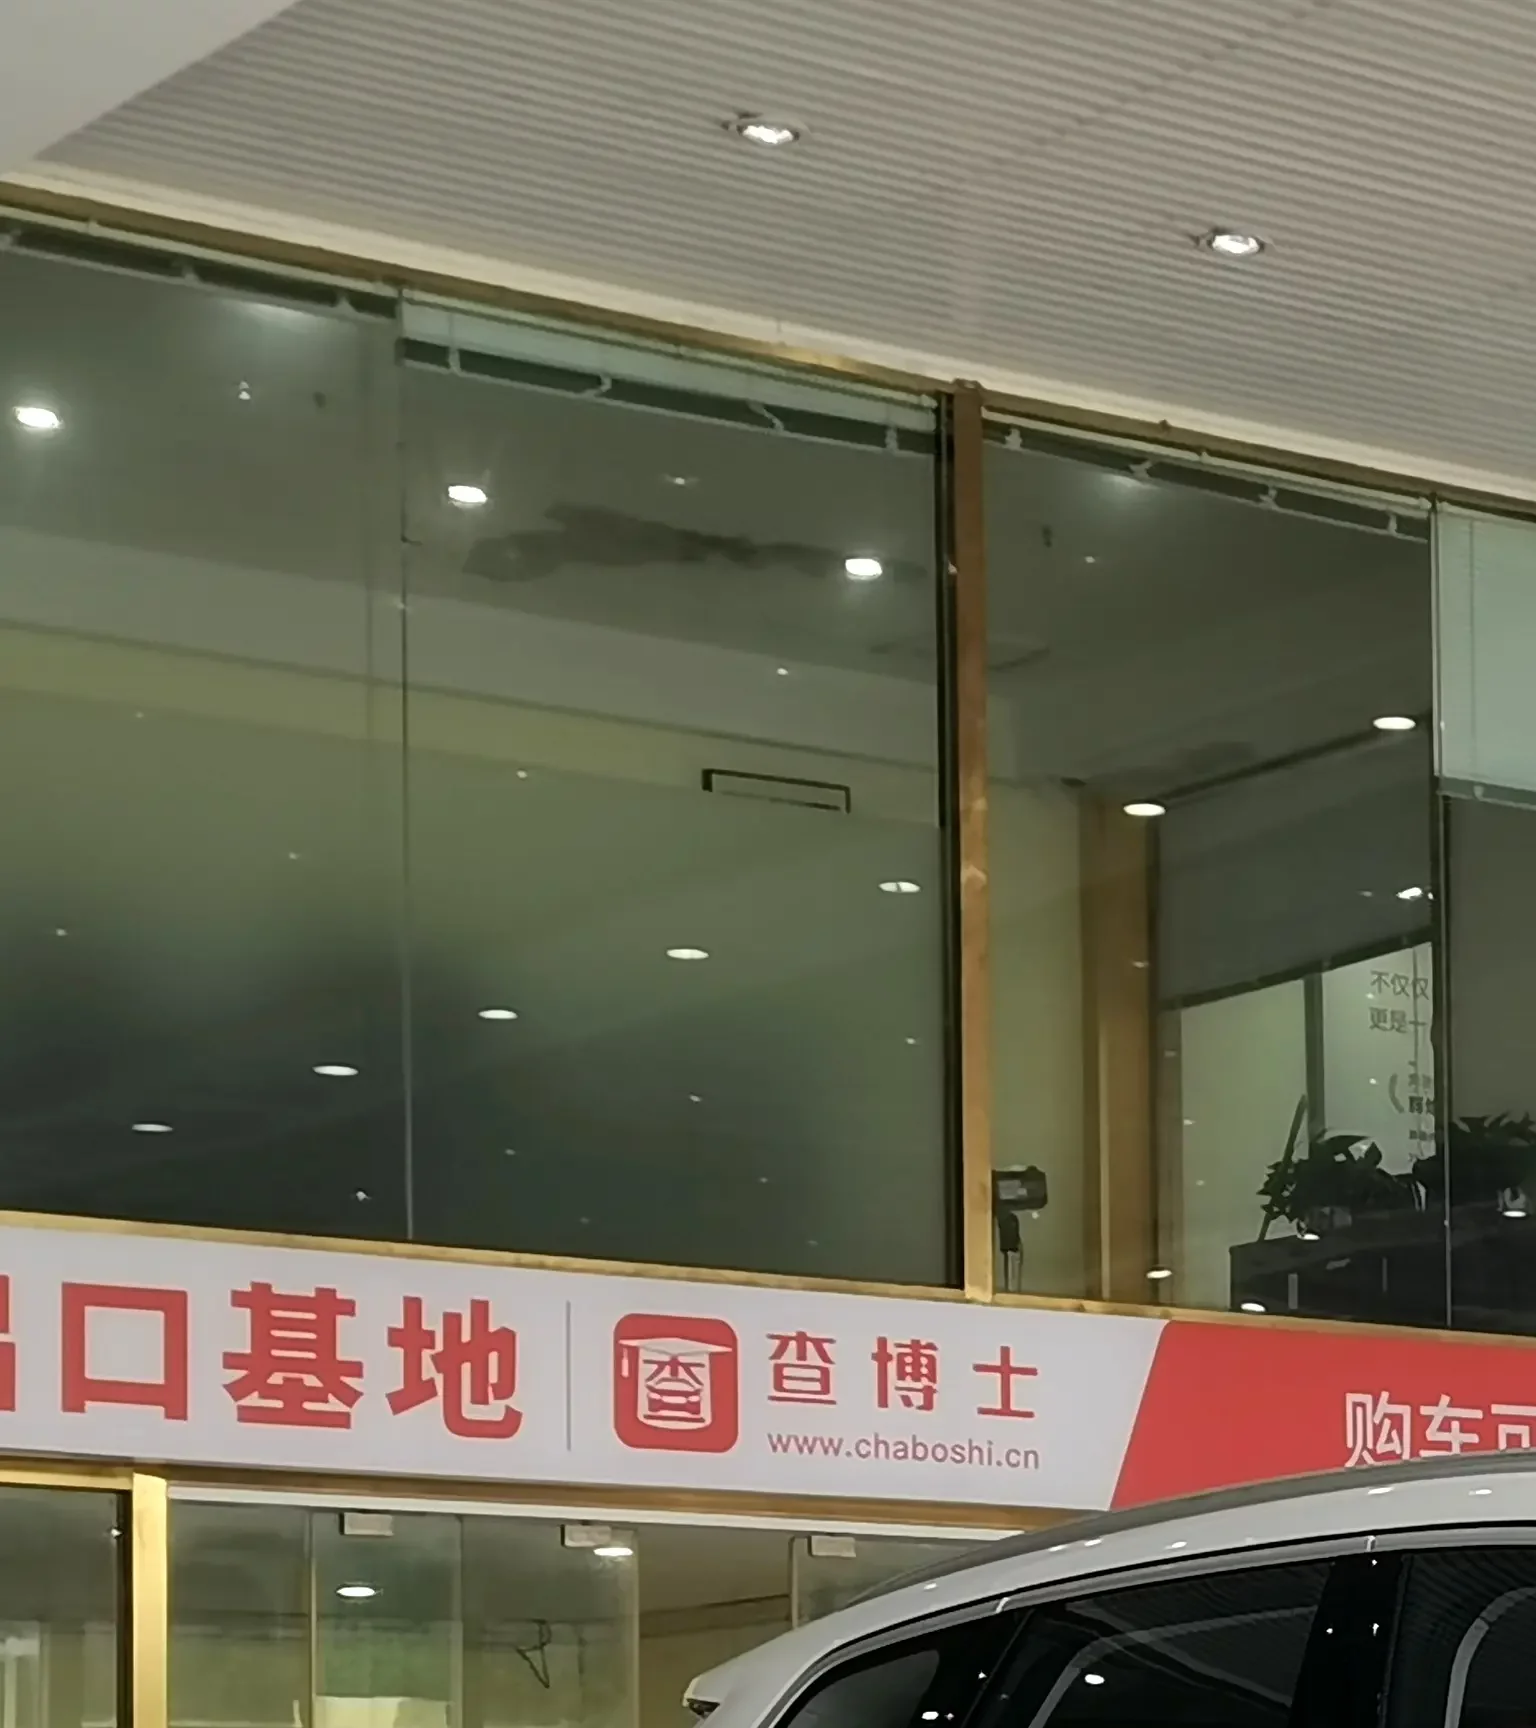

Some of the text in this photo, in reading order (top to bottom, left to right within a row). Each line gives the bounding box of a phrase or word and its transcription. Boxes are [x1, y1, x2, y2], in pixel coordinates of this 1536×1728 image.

[0, 1275, 523, 1440] 口基地
[766, 1331, 1039, 1419] 查博士
[767, 1431, 1040, 1470] www.chaboshi.cn
